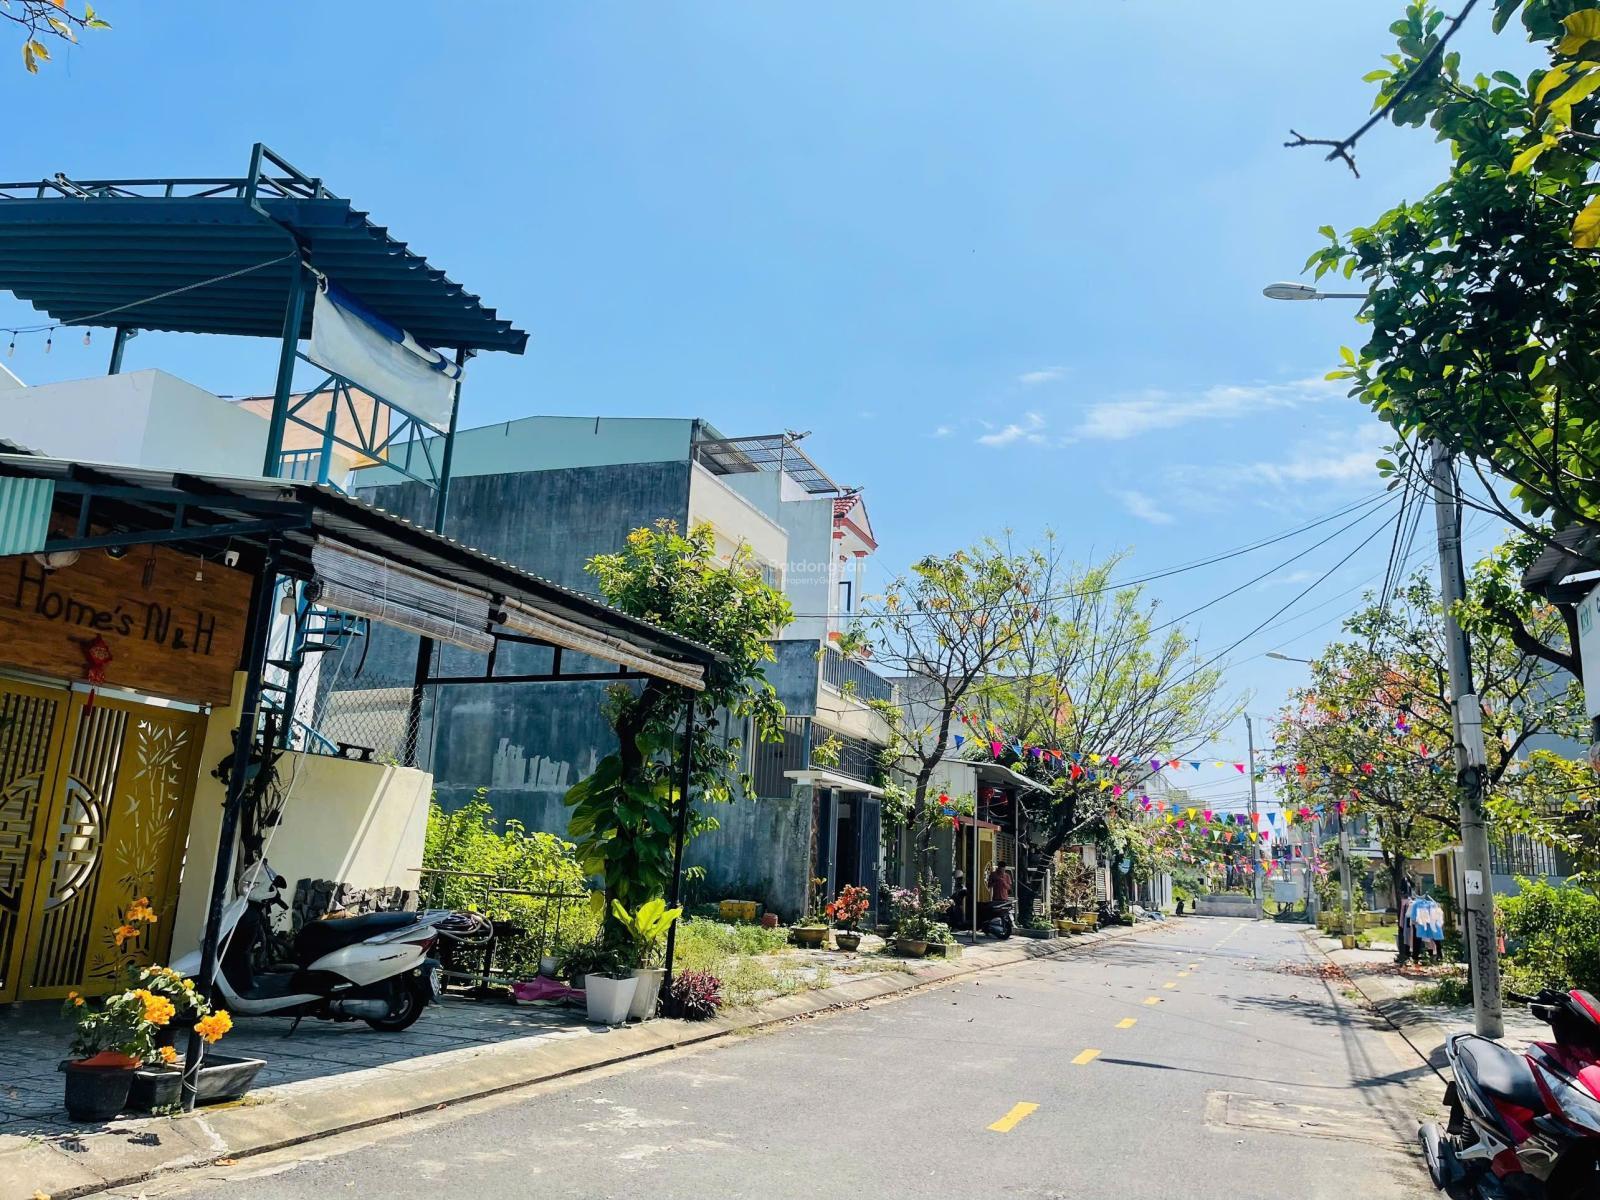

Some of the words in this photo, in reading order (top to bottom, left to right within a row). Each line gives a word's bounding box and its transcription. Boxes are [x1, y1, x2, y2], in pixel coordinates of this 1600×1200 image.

[15, 559, 134, 637] Home's
[143, 602, 171, 644] N
[172, 627, 188, 650] &
[193, 611, 215, 656] H
